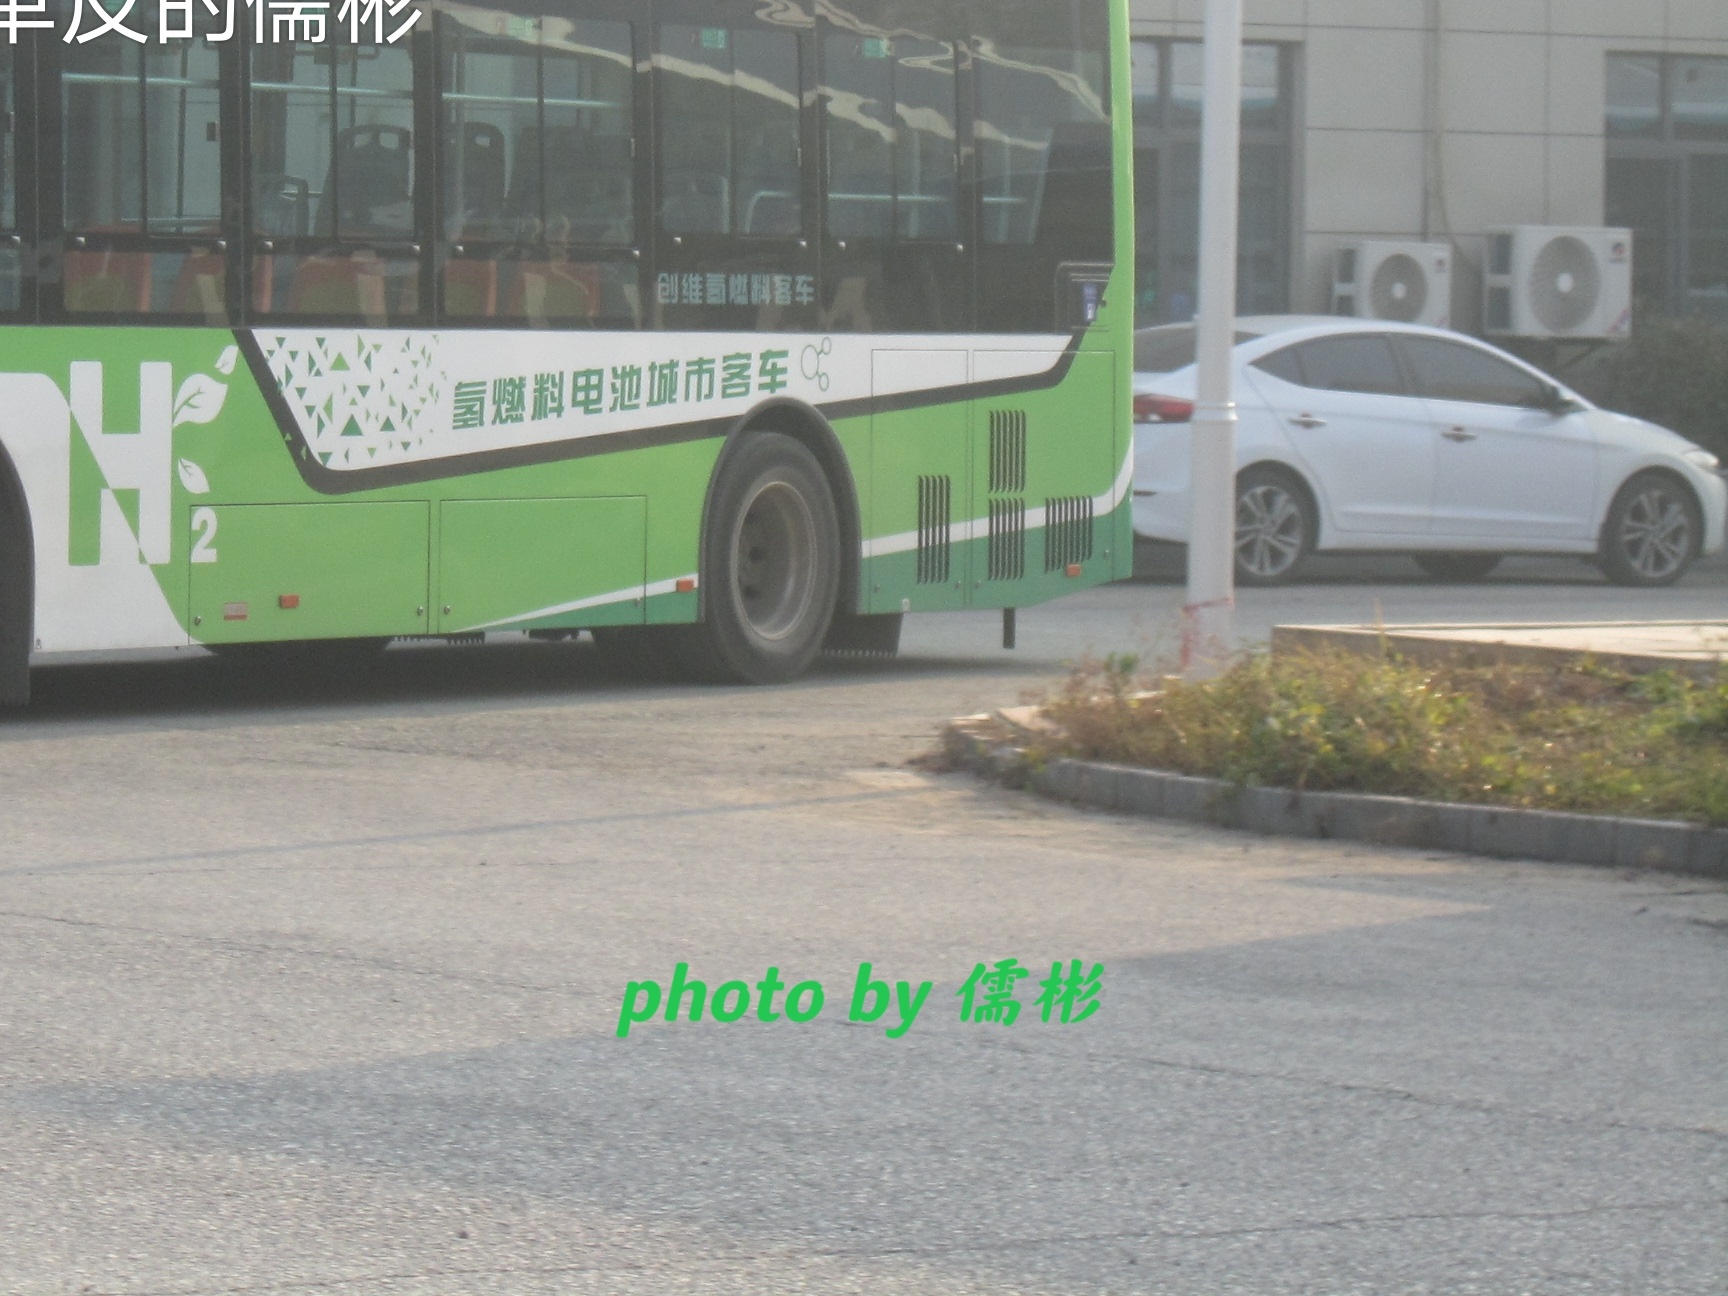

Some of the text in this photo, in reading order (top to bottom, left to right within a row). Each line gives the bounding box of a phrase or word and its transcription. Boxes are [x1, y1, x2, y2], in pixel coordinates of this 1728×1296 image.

[452, 349, 790, 431] 氢燃料电池城市客车
